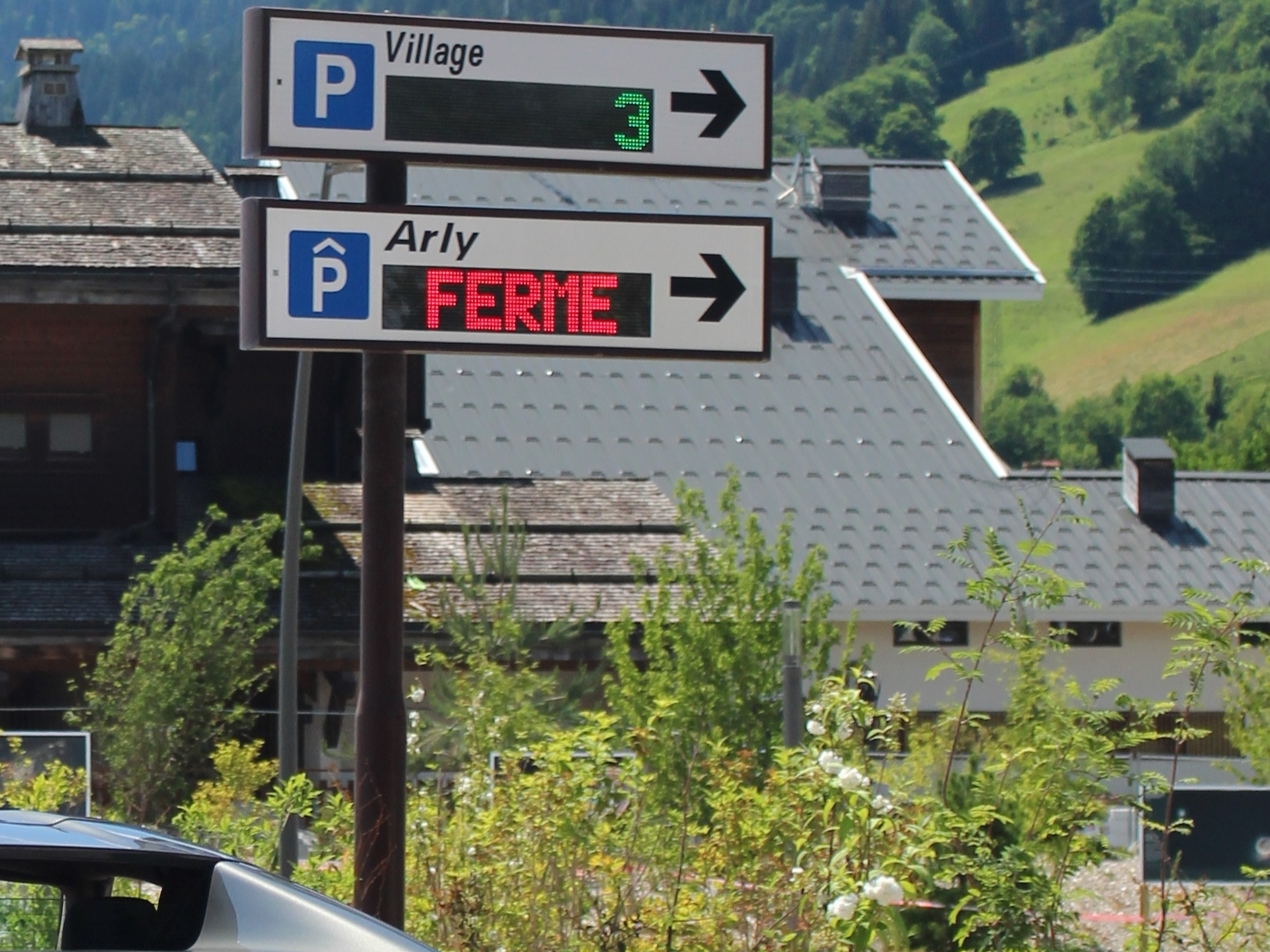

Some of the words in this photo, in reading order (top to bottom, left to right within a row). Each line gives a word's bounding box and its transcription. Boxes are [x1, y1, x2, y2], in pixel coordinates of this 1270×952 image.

[385, 31, 484, 75] Village
[314, 53, 357, 120] P
[613, 91, 651, 152] 3
[384, 219, 480, 261] Arly
[425, 268, 619, 335] FERME
